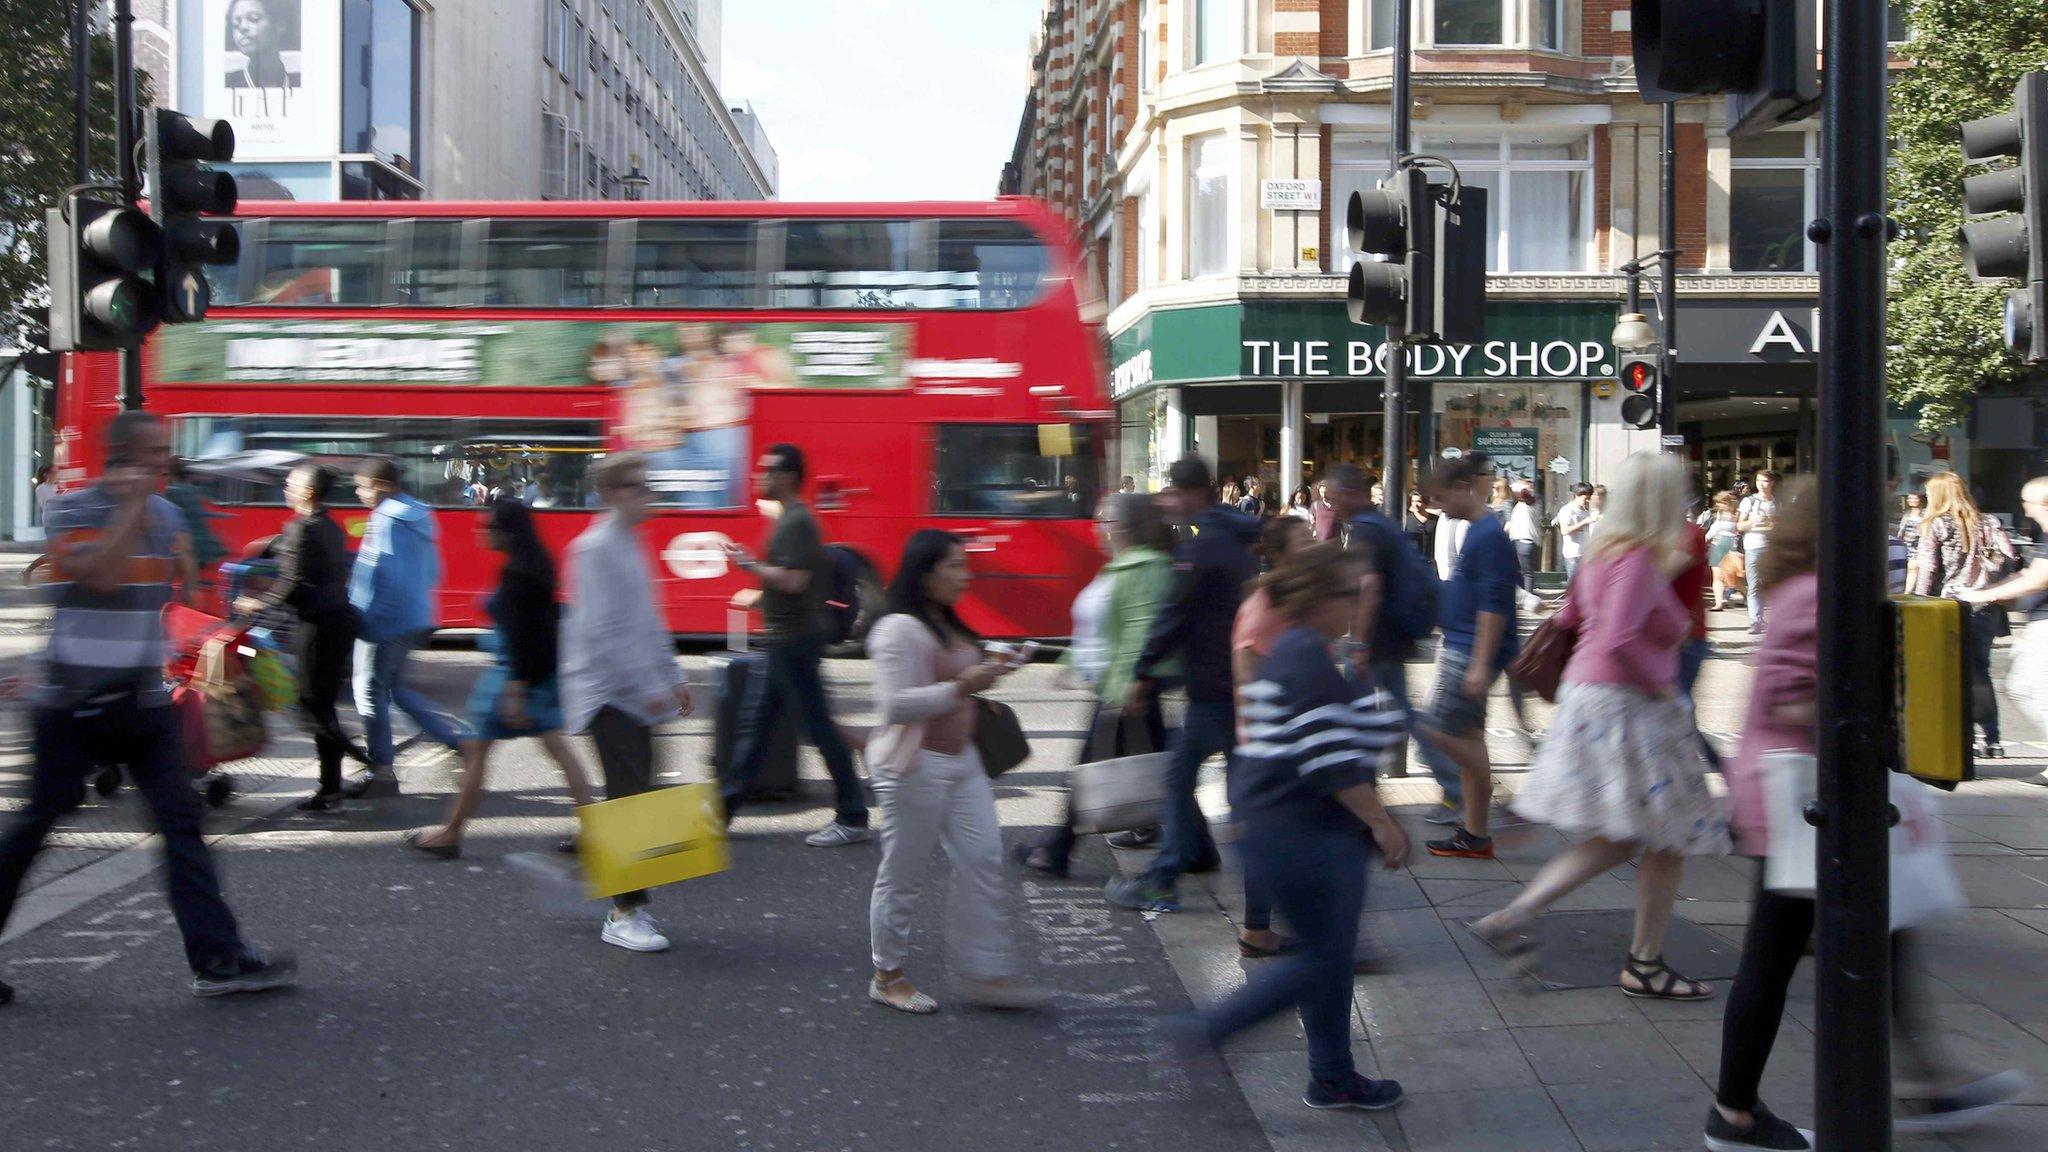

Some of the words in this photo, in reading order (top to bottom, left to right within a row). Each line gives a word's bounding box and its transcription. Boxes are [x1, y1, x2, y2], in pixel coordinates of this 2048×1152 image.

[1266, 182, 1306, 191] OXFORD
[1266, 191, 1301, 200] STREET
[1303, 191, 1318, 200] W1
[1242, 341, 1330, 376] THE
